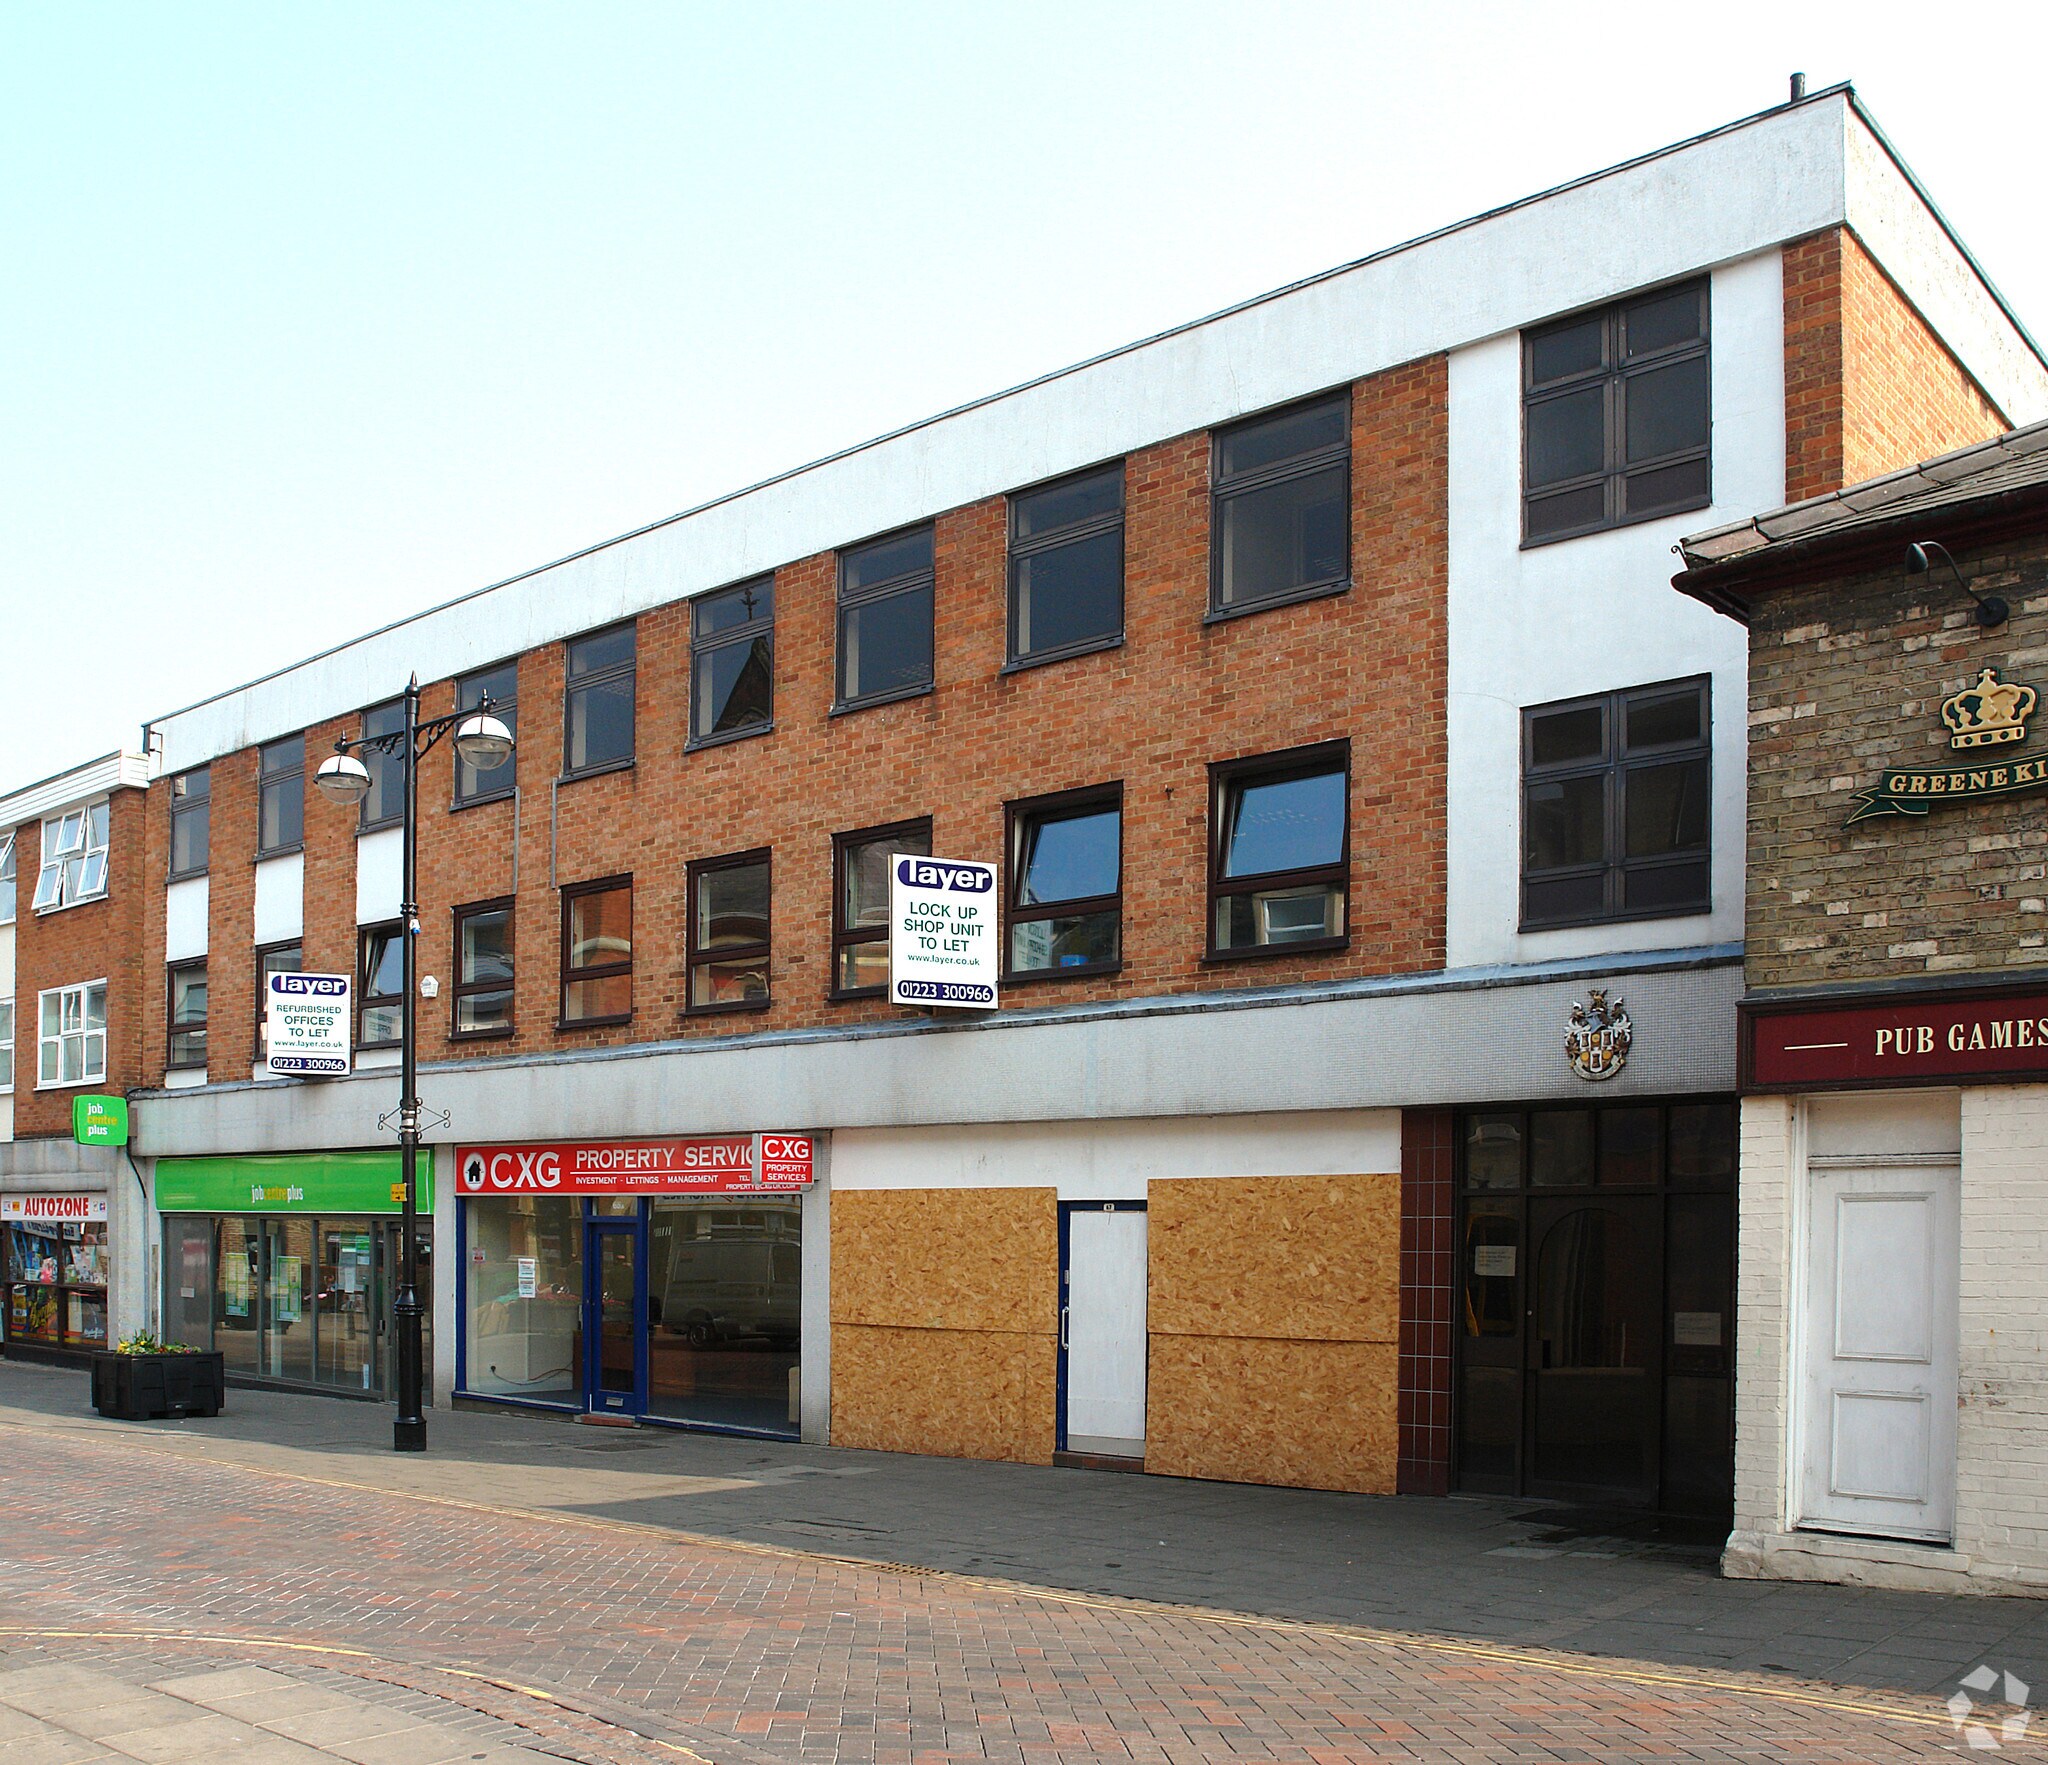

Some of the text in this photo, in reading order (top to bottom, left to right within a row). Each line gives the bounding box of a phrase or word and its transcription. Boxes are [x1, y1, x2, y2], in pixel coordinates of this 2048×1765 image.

[1889, 768, 2008, 793] GREENE
[908, 860, 990, 891] layer
[910, 902, 978, 919] LOCK UP
[904, 919, 984, 937] SHOP UNIT
[918, 937, 970, 952] TO LET
[908, 954, 980, 966] www.layer.co.uk
[280, 975, 345, 996] layer
[900, 982, 991, 1001] 01223 300966
[276, 1005, 342, 1014] REFURBISHED
[284, 1016, 334, 1026] OFFICES
[289, 1028, 330, 1037] TO LET
[1875, 1018, 2048, 1056] PUB GAMES
[275, 1040, 343, 1048] www.layer.co.uk
[272, 1058, 344, 1070] 01223 300966
[87, 1103, 103, 1116] job
[87, 1115, 118, 1125] centre
[87, 1124, 108, 1137] plus
[764, 1139, 809, 1159] CXG
[576, 1147, 675, 1169] PROPERTY
[490, 1151, 562, 1189] CXG
[766, 1164, 807, 1172] PROPERTY
[575, 1175, 718, 1184] INVESTMENT LETTINGS MANAGEMENT
[767, 1173, 807, 1181] SERVICES
[24, 1197, 89, 1217] AUTOZONE
